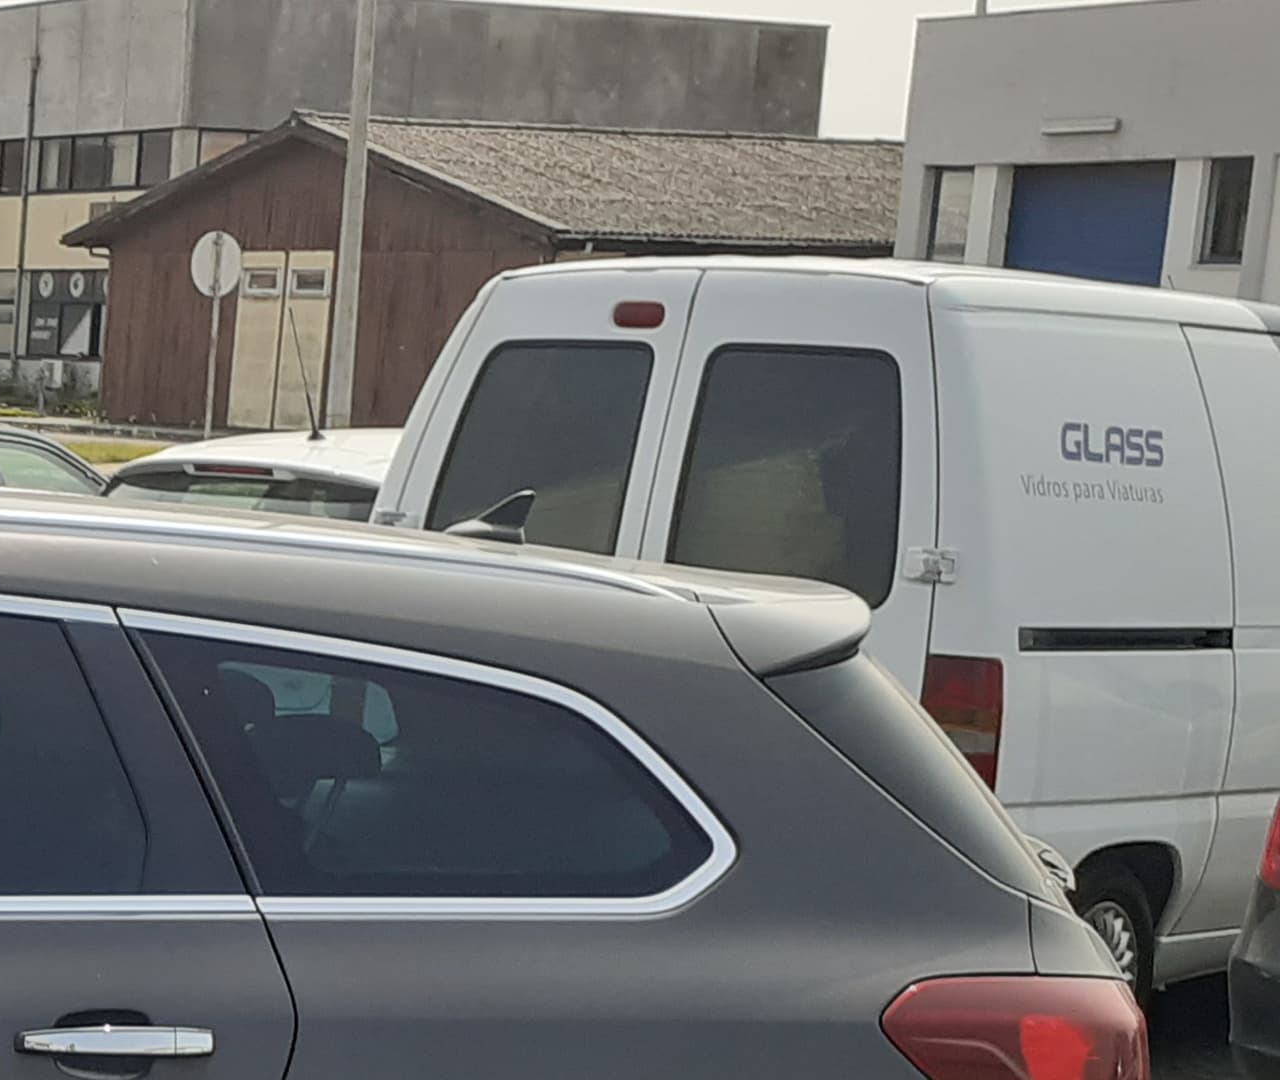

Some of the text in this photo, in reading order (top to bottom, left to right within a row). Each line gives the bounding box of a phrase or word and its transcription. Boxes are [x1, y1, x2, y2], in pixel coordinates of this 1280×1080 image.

[1060, 421, 1164, 468] GLASS
[1020, 473, 1164, 504] Vidros para Viaturas
